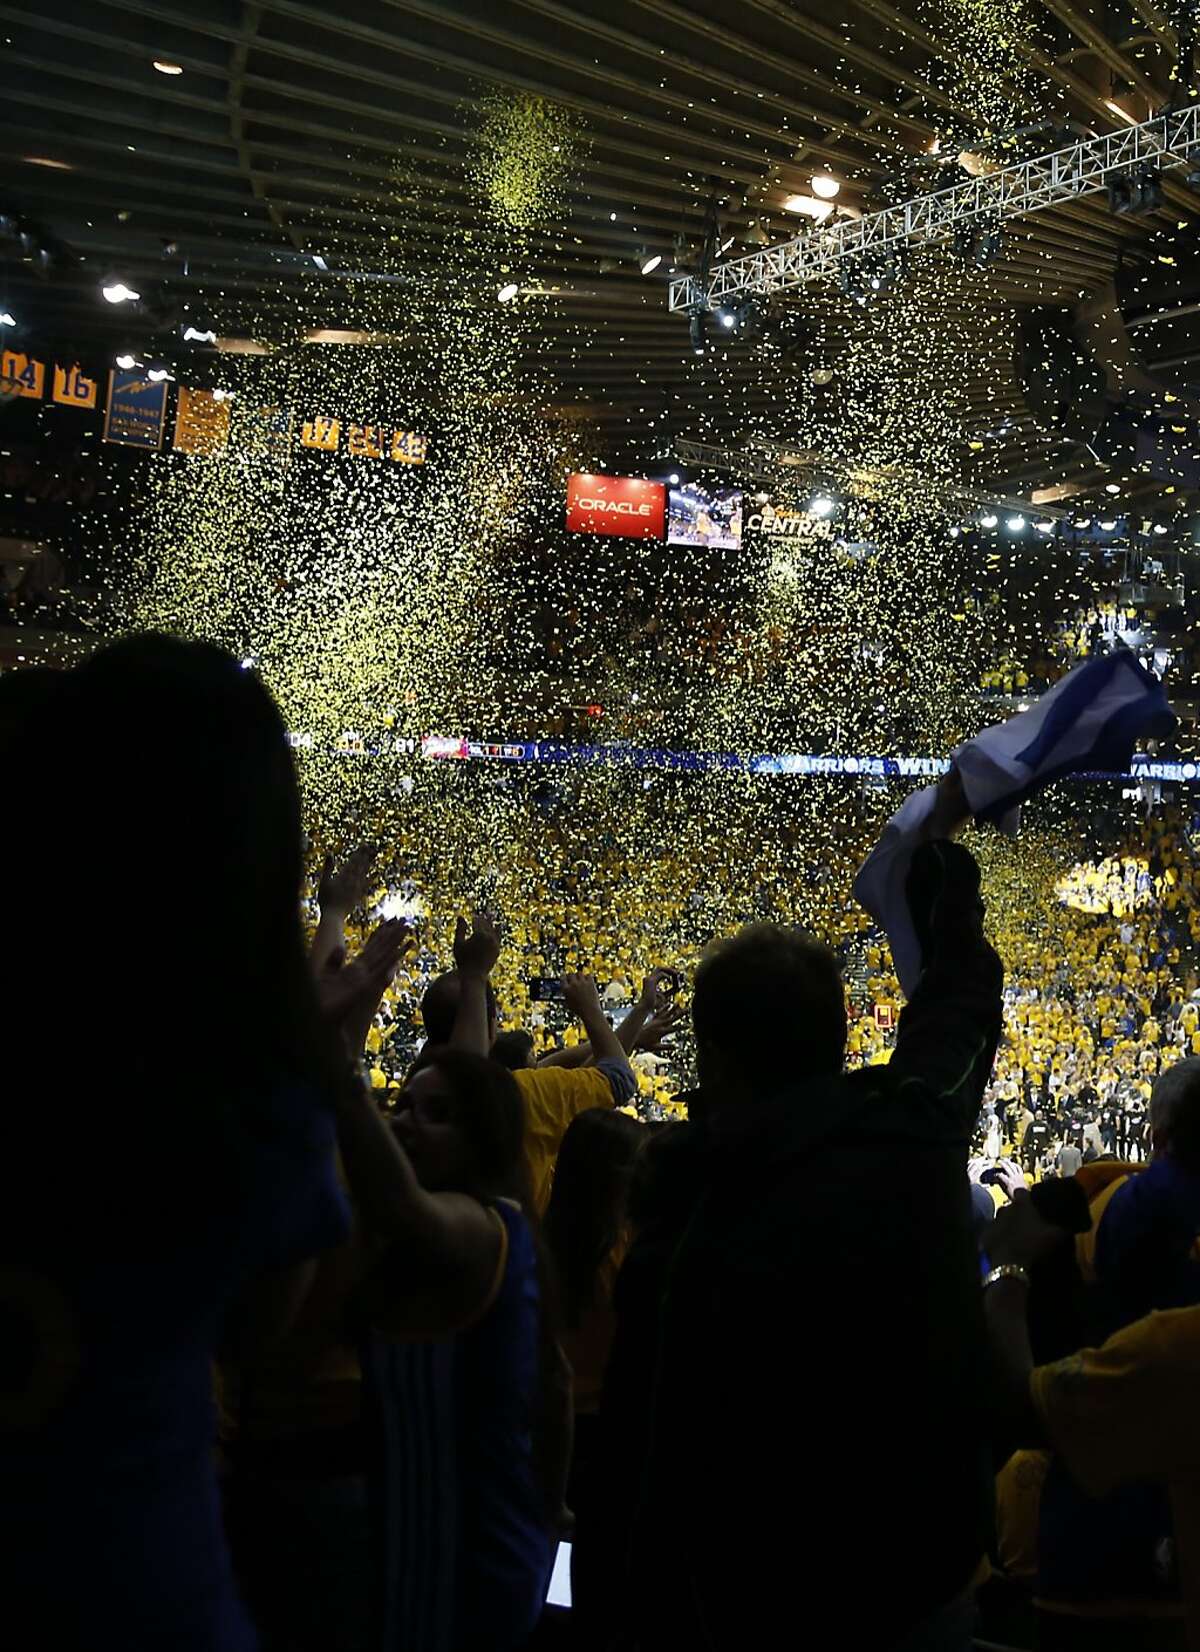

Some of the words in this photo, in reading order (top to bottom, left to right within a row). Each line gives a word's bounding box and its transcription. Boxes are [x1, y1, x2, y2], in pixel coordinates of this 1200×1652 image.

[7, 359, 36, 390] 14
[62, 368, 90, 398] 16
[579, 498, 653, 516] ORACLE
[748, 514, 832, 539] CENTRAL
[777, 755, 884, 774] WARRIORS
[897, 757, 950, 774] WIN
